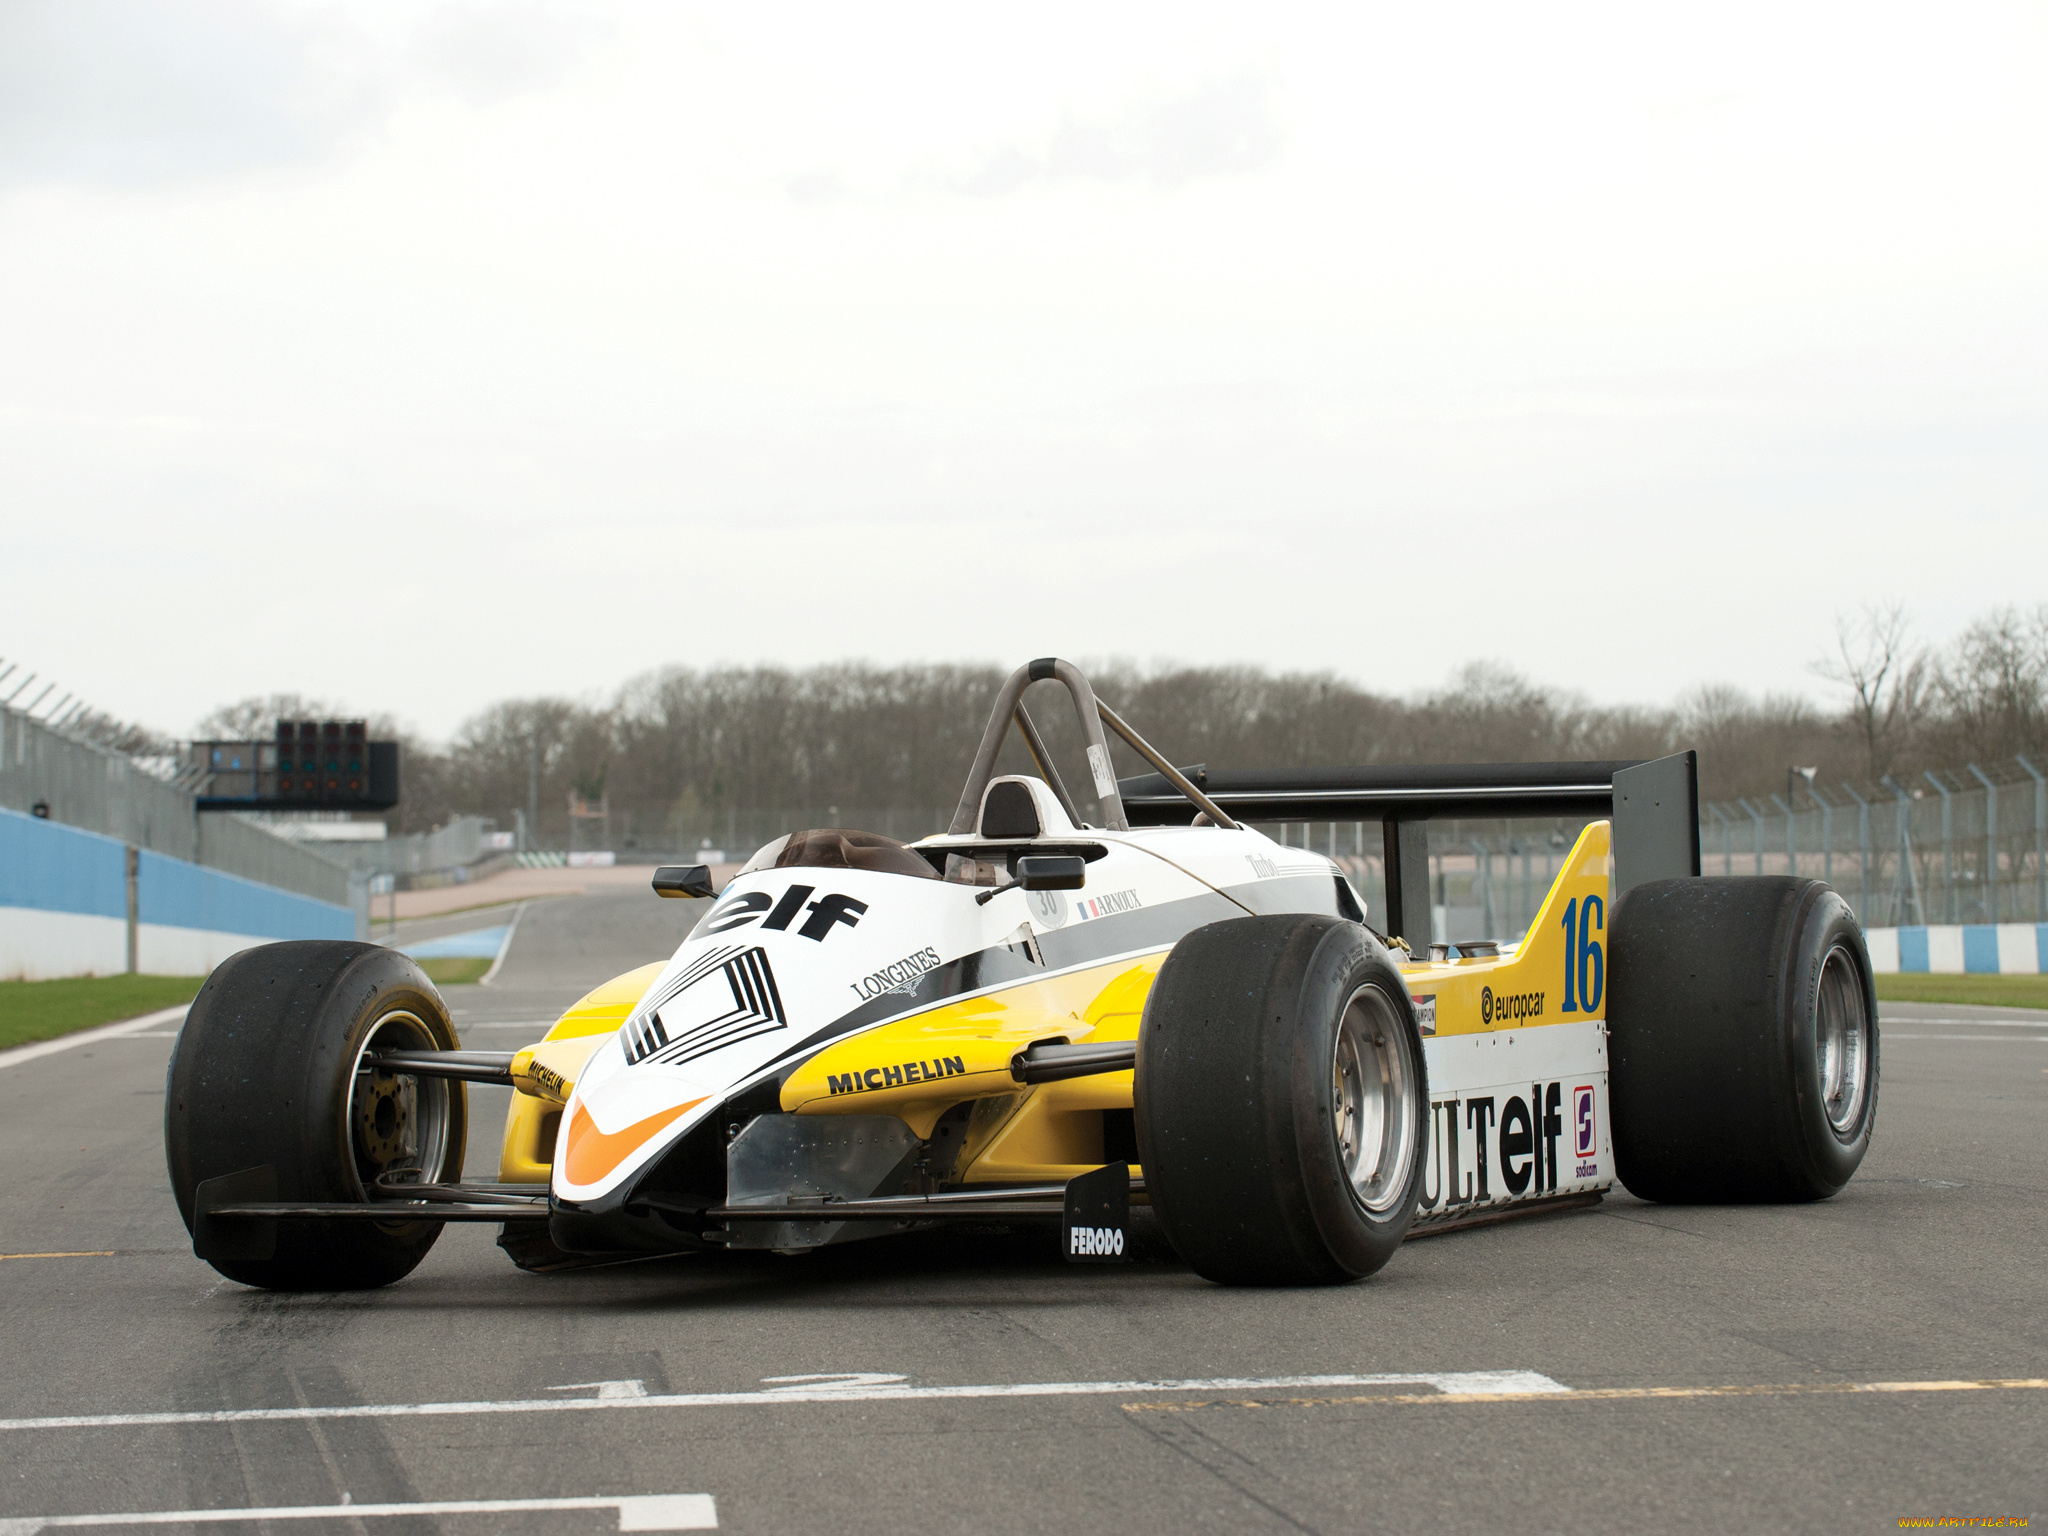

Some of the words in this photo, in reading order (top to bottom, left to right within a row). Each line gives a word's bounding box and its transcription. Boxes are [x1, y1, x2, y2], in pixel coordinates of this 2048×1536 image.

[1245, 853, 1280, 878] Turbo
[689, 884, 869, 943] elf
[1036, 889, 1059, 916] 30
[1096, 889, 1142, 916] ARNOUX
[1561, 894, 1604, 1013] 16
[850, 946, 941, 1001] LONGINES
[1495, 991, 1545, 1026] europcar
[528, 1059, 567, 1095] MICHELIN
[827, 1055, 966, 1095] MICHELIN
[1500, 1082, 1562, 1195] elf
[1071, 1226, 1124, 1256] FERODO
